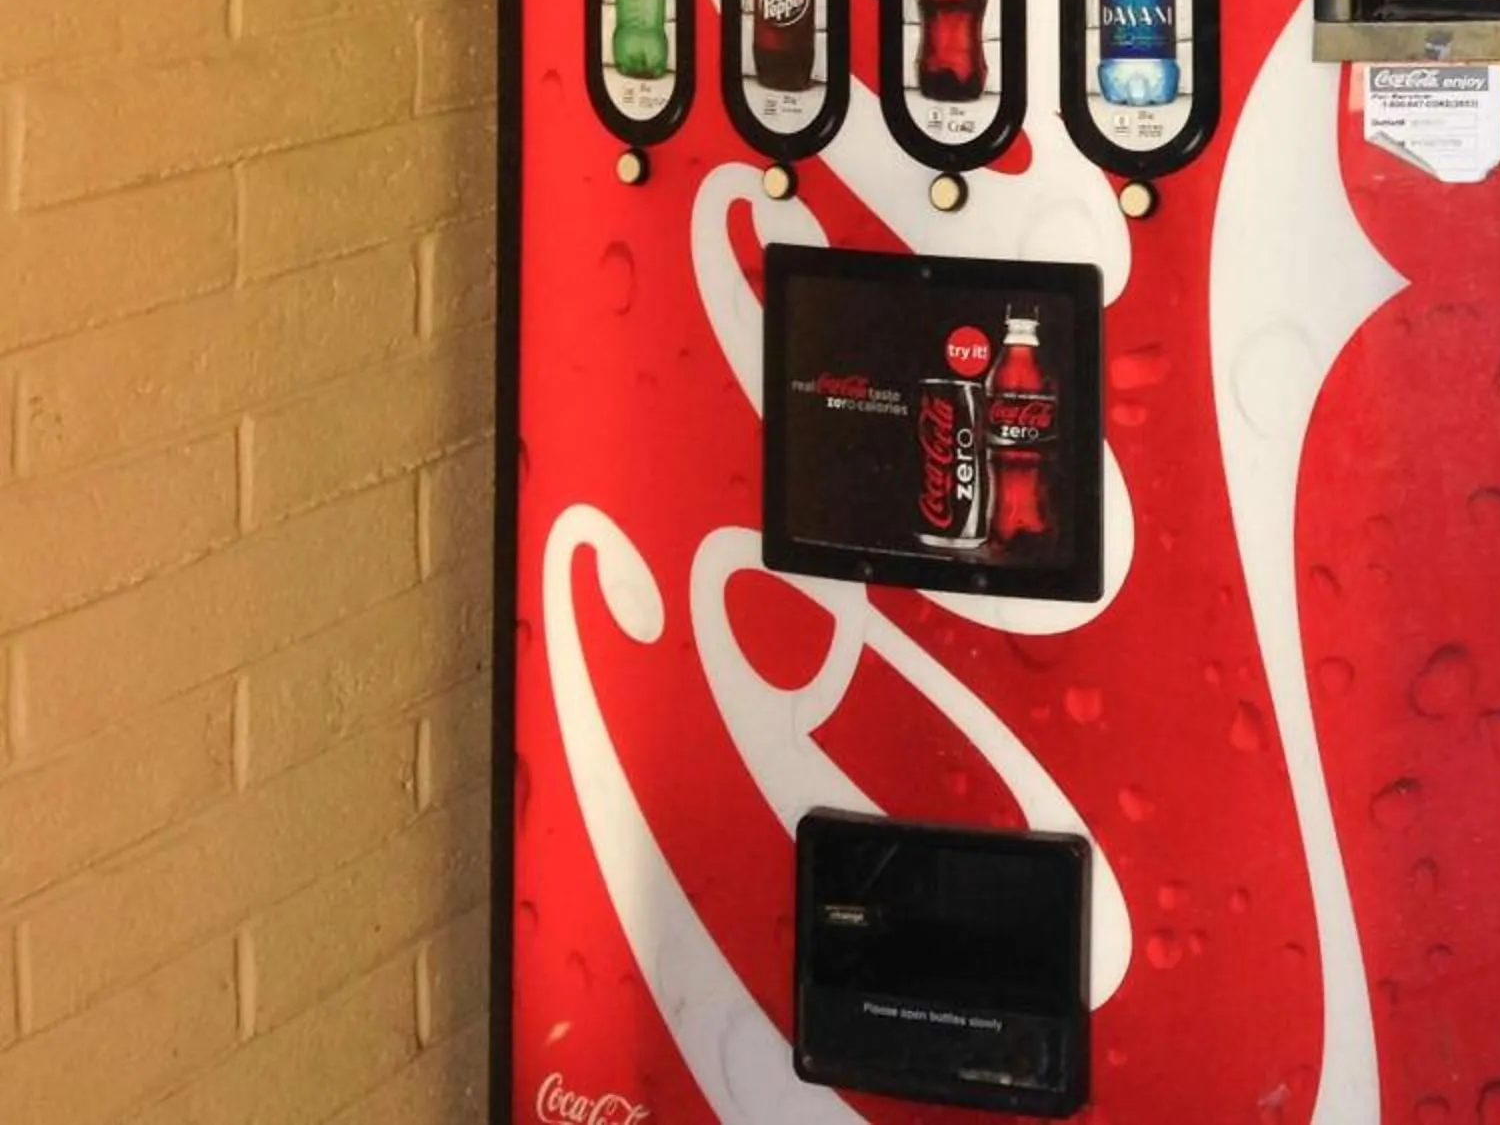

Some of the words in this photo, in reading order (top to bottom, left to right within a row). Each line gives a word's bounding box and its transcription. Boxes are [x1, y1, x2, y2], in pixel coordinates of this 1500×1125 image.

[1103, 6, 1173, 26] DASANI
[1442, 76, 1487, 90] enjoy
[948, 344, 970, 361] try
[972, 345, 988, 360] it!
[827, 397, 856, 410] zero
[1001, 425, 1039, 439] zero
[956, 428, 973, 501] zero
